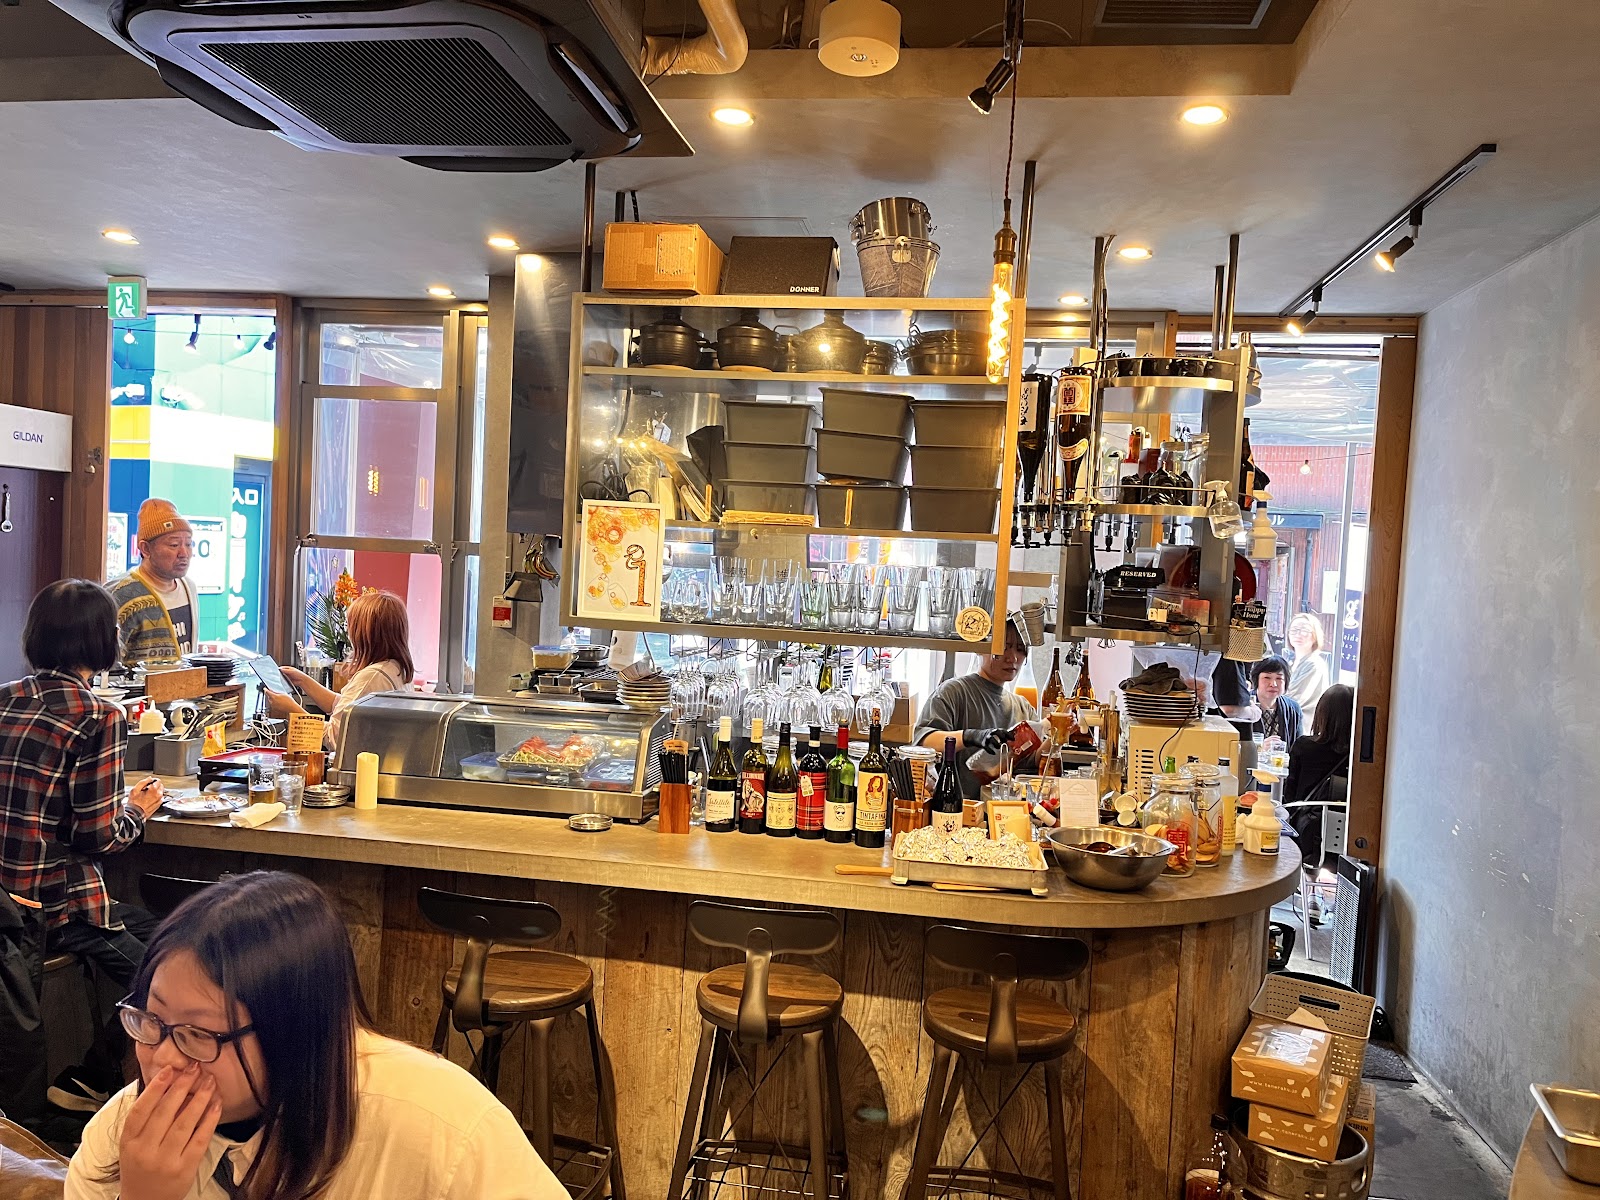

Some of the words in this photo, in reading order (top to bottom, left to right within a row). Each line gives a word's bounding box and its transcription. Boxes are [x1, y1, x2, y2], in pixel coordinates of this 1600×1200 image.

[13, 430, 44, 443] GILDAN
[232, 487, 259, 506] 入口
[1120, 570, 1157, 578] RESERVED
[1242, 611, 1261, 619] Hour
